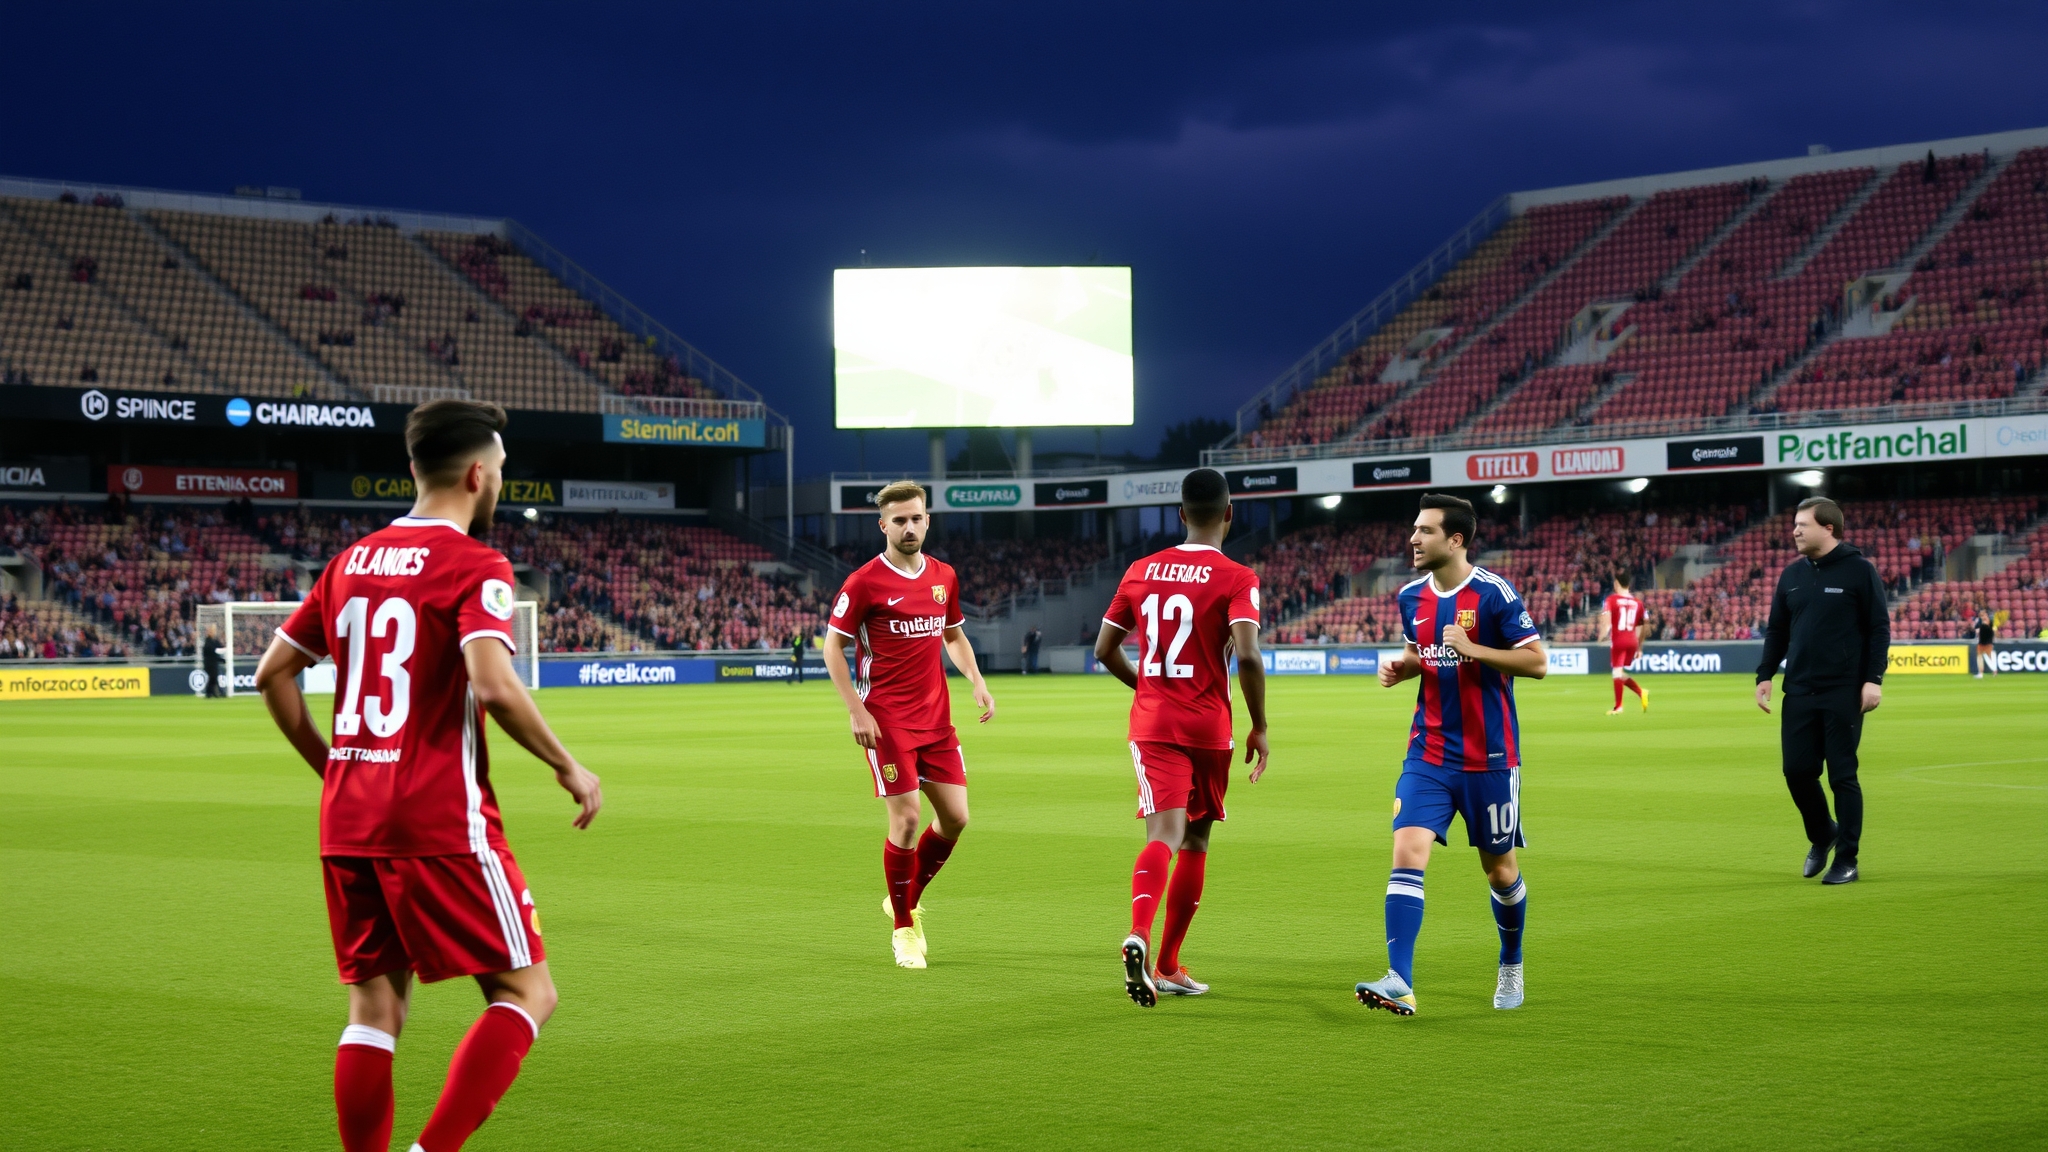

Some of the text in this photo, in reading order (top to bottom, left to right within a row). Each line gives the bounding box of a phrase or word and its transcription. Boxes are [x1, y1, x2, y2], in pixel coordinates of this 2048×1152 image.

[256, 402, 375, 427] CHAIRACOA
[1141, 593, 1194, 678] 12
[335, 597, 416, 738] 13
[1487, 801, 1514, 834] 10
